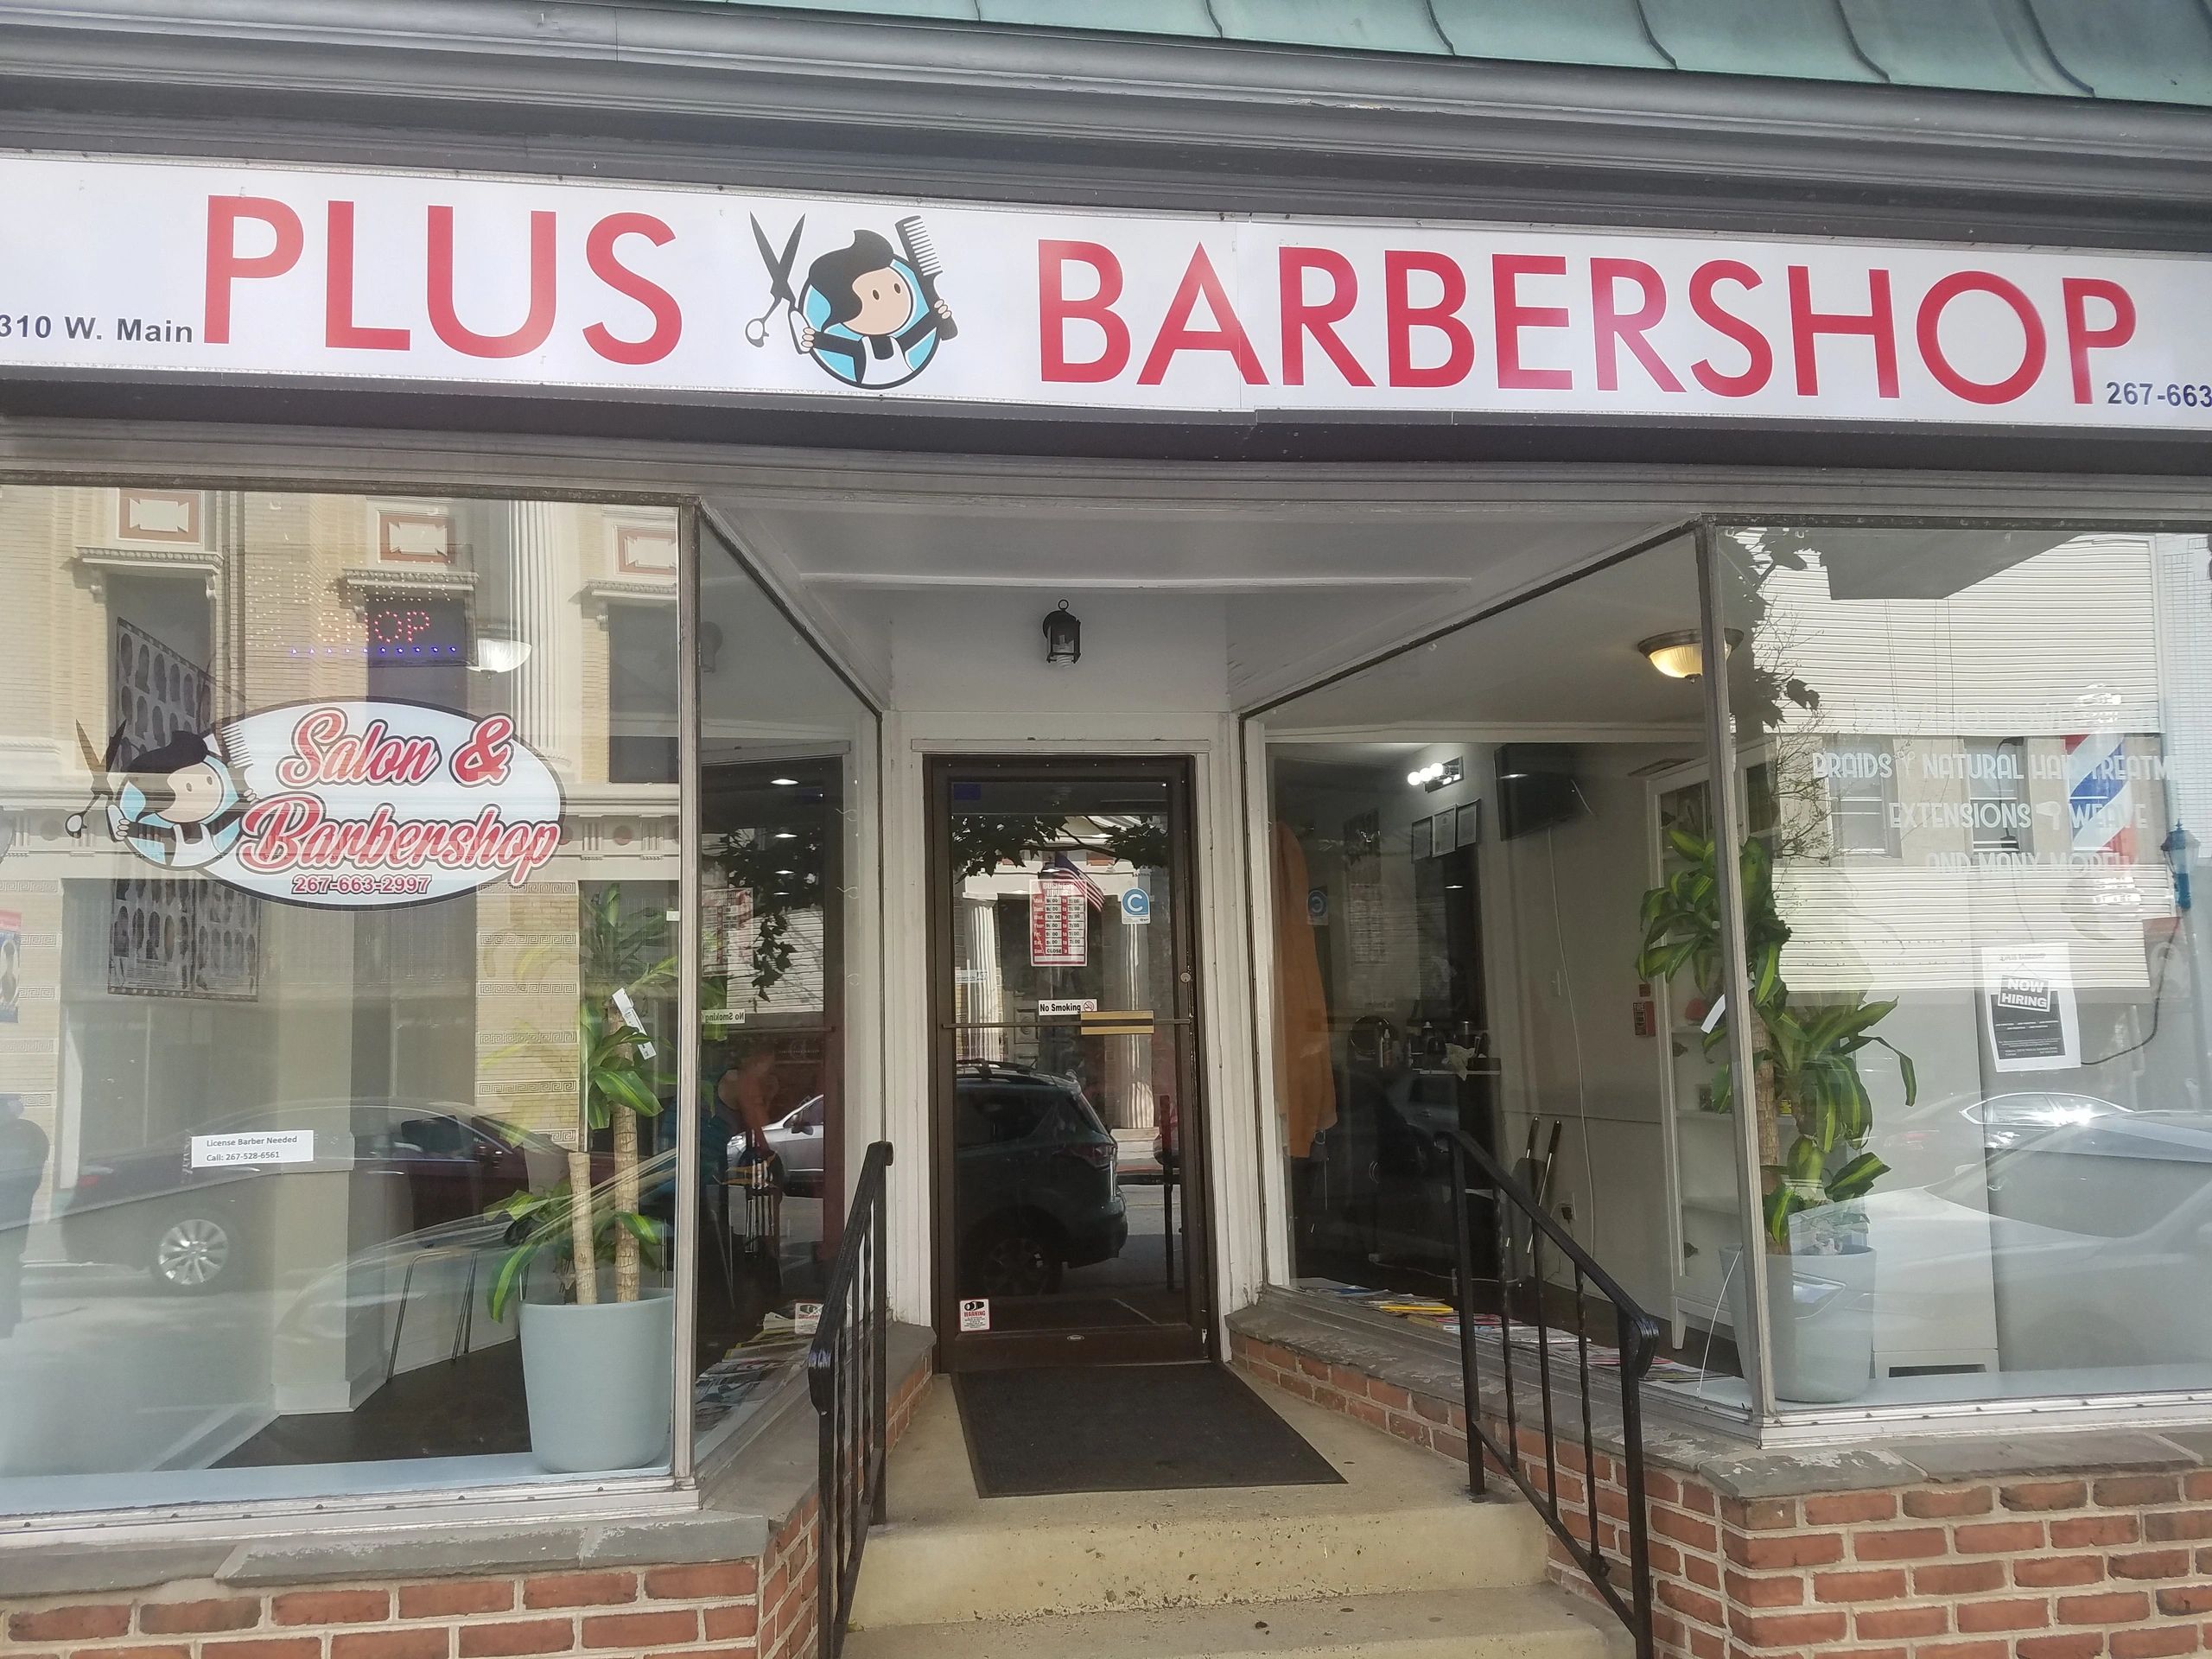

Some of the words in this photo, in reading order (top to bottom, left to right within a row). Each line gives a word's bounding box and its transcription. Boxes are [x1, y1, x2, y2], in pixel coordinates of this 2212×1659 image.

[205, 196, 681, 365] PLUS
[1039, 241, 2135, 404] BARBERSHOP
[0, 314, 52, 339] 310
[64, 316, 102, 340] W.
[117, 317, 193, 343] Main
[316, 610, 430, 643] SHOP
[277, 709, 441, 786] Salon
[451, 715, 513, 785] &
[1812, 752, 1893, 779] BRAIDS
[1922, 753, 2024, 779] NATURAL
[1888, 801, 2031, 830] EXTENSIONS
[237, 792, 561, 887] Barbershop
[293, 874, 432, 893] 267-663-2997
[2007, 978, 2044, 993] NOW
[1039, 1003, 1050, 1012] No
[1051, 1002, 1081, 1014] Smoking
[2001, 993, 2048, 1007] HIRING
[207, 1139, 236, 1147] License
[238, 1137, 264, 1146] Barber
[266, 1135, 297, 1144] Needed
[226, 1151, 280, 1161] 267-528-6561
